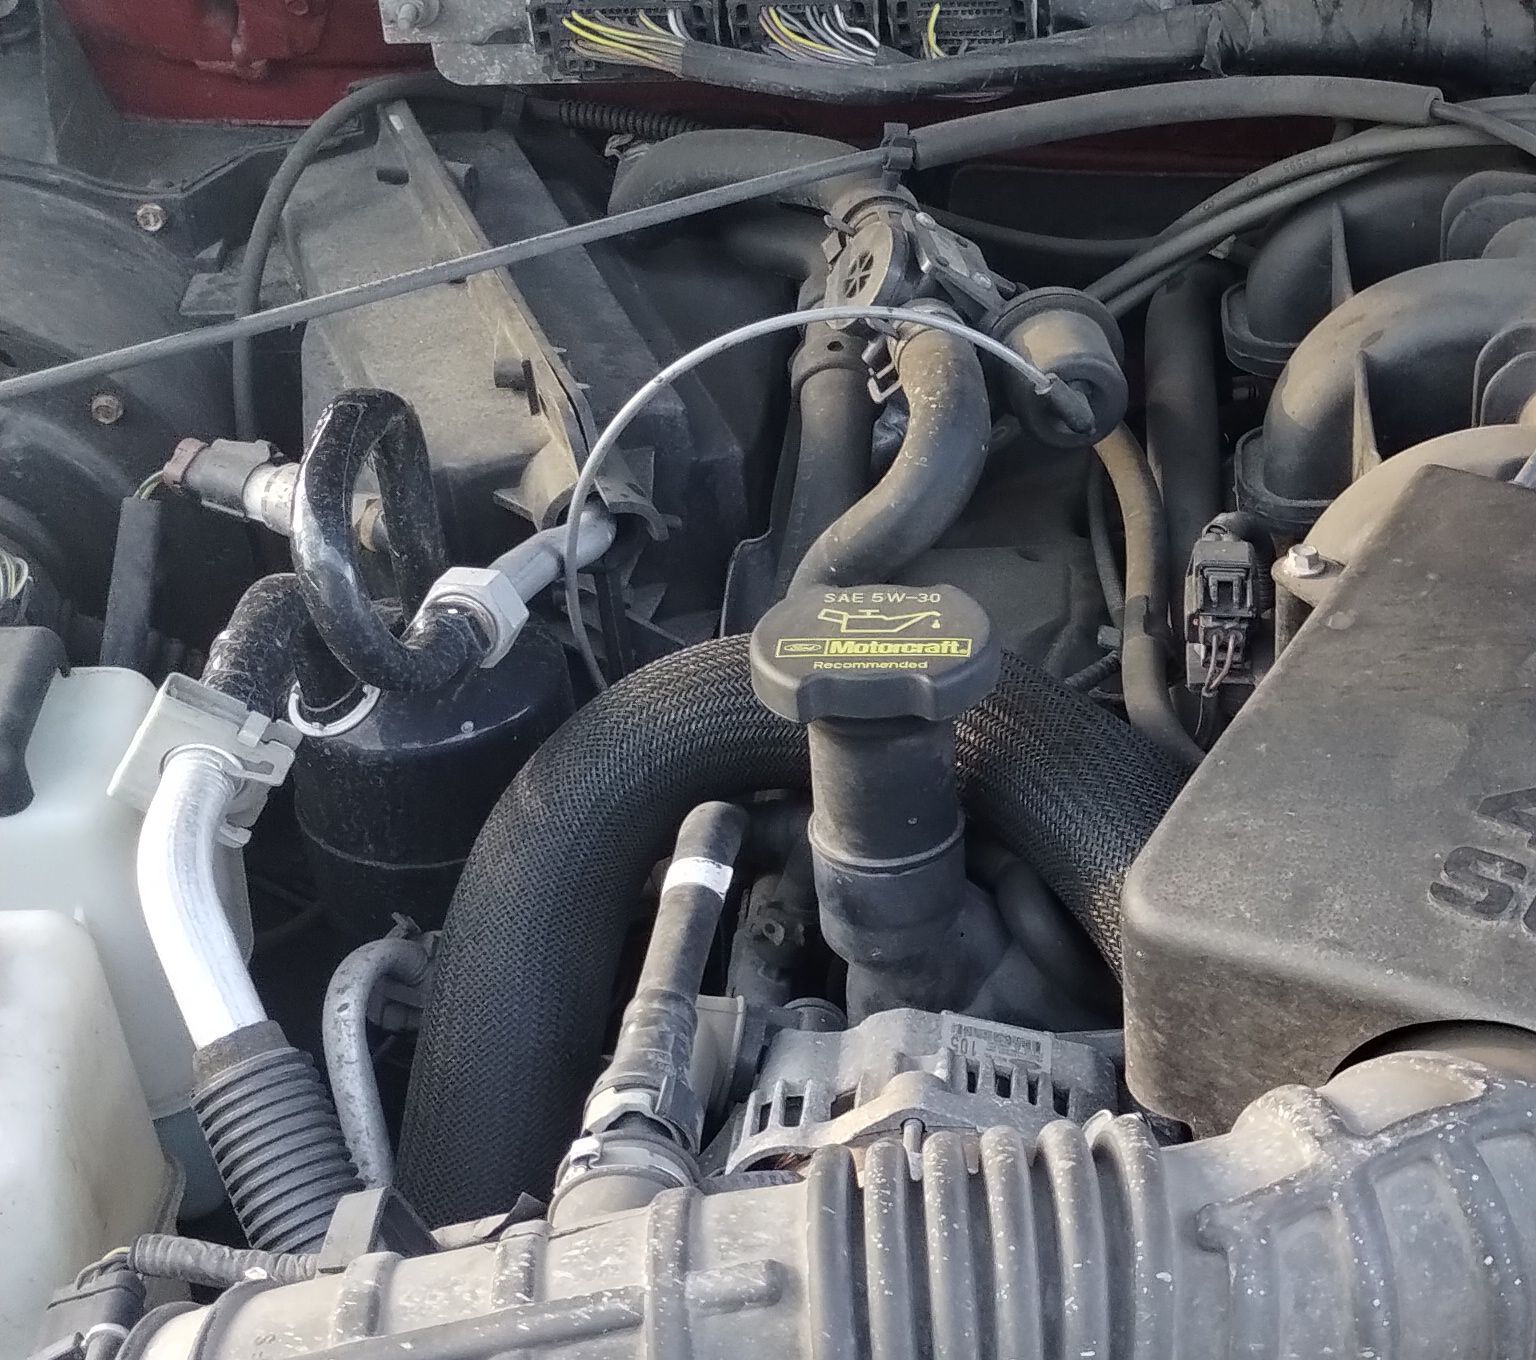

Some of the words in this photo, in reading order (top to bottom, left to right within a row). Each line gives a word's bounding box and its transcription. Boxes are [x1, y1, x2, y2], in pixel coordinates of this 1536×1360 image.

[824, 592, 865, 603] SAE
[871, 592, 941, 603] 5W-30
[813, 661, 928, 670] Recommended
